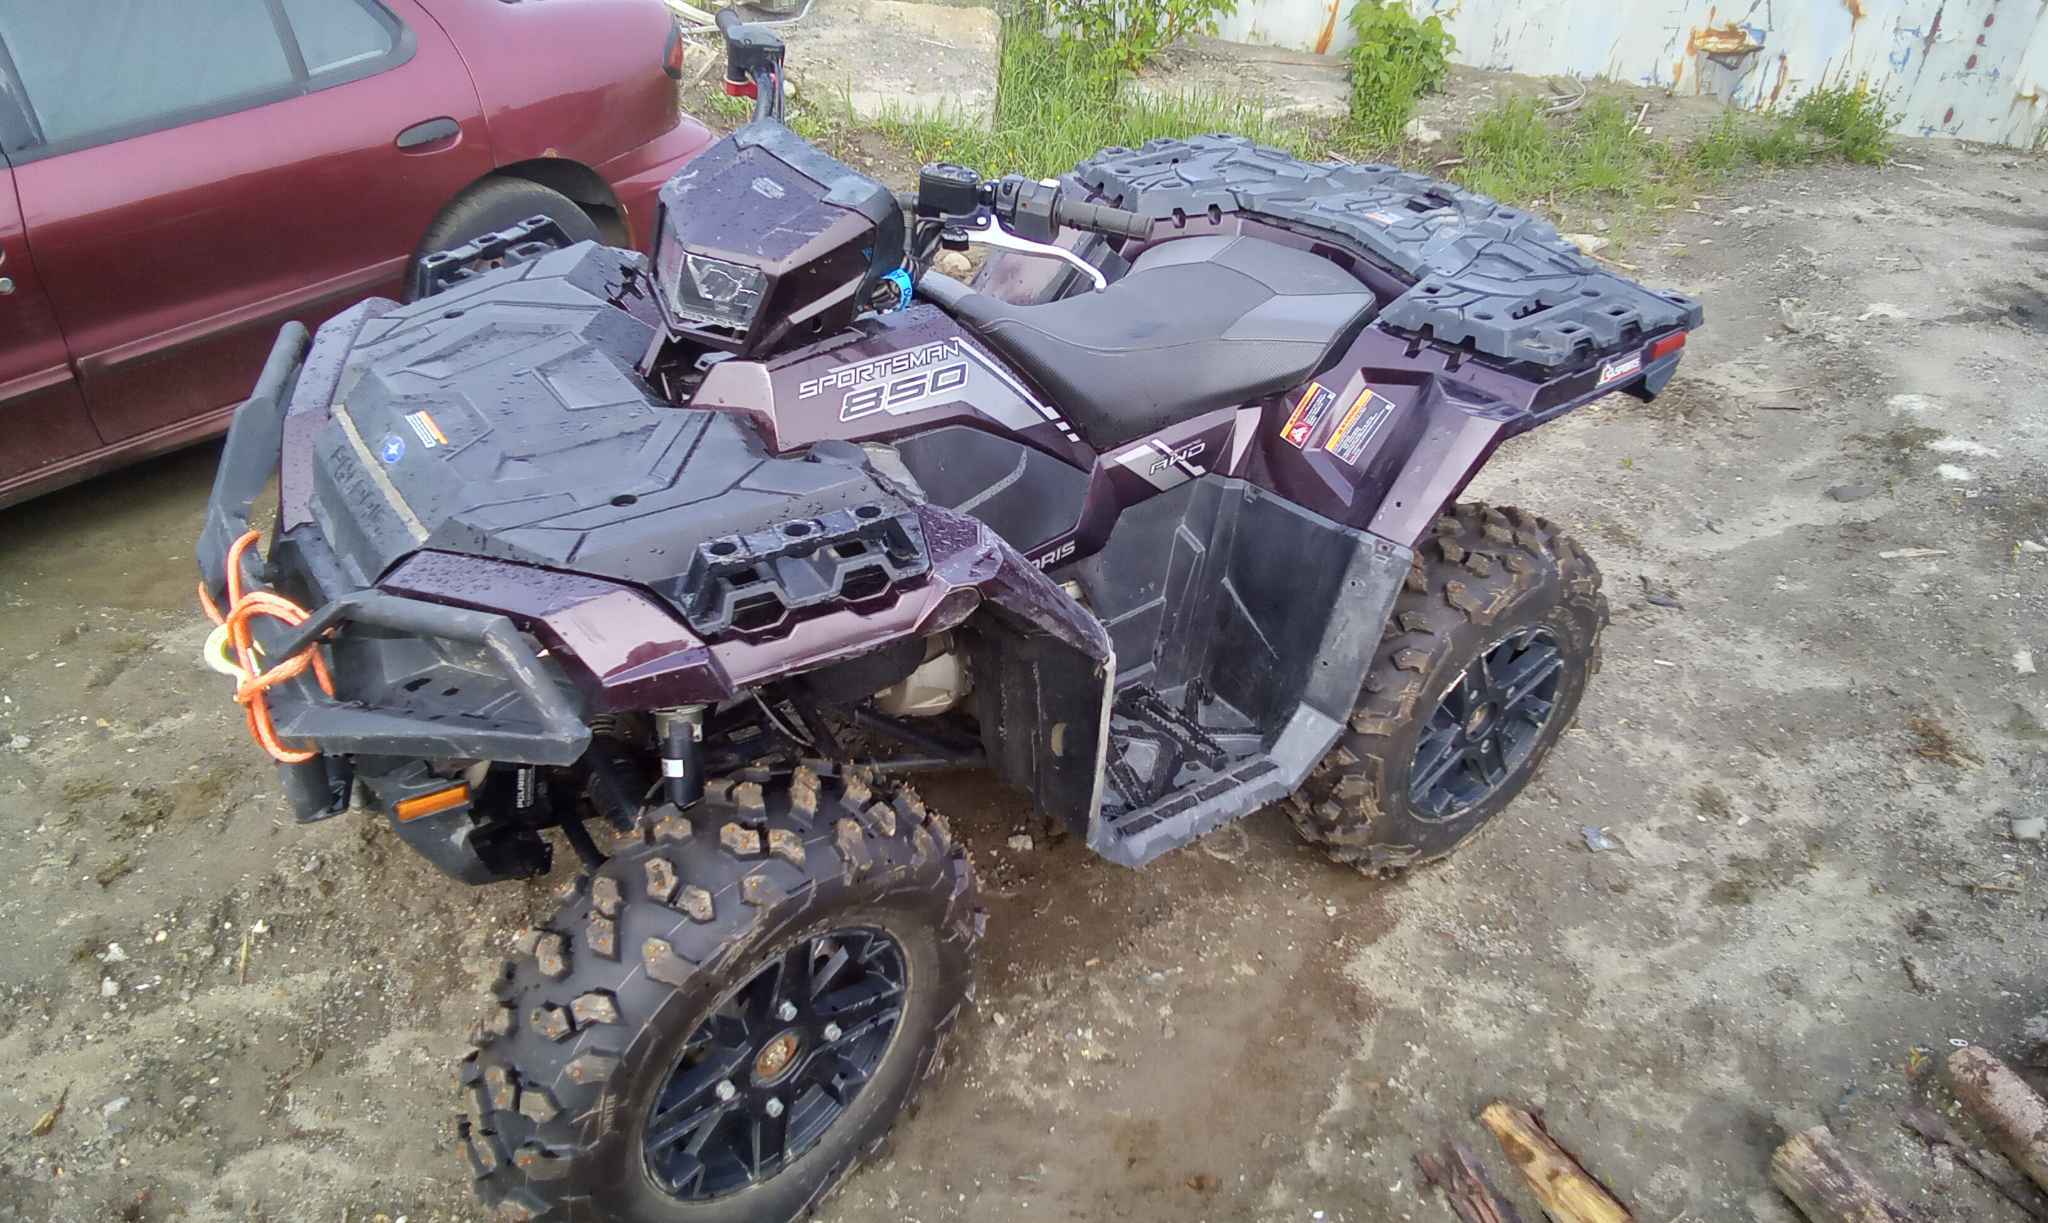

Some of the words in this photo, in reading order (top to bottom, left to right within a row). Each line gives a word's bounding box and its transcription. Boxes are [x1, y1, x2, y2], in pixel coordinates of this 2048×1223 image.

[799, 341, 960, 400] SPORTSMAN
[839, 361, 968, 422] 850
[1149, 442, 1206, 476] AWD
